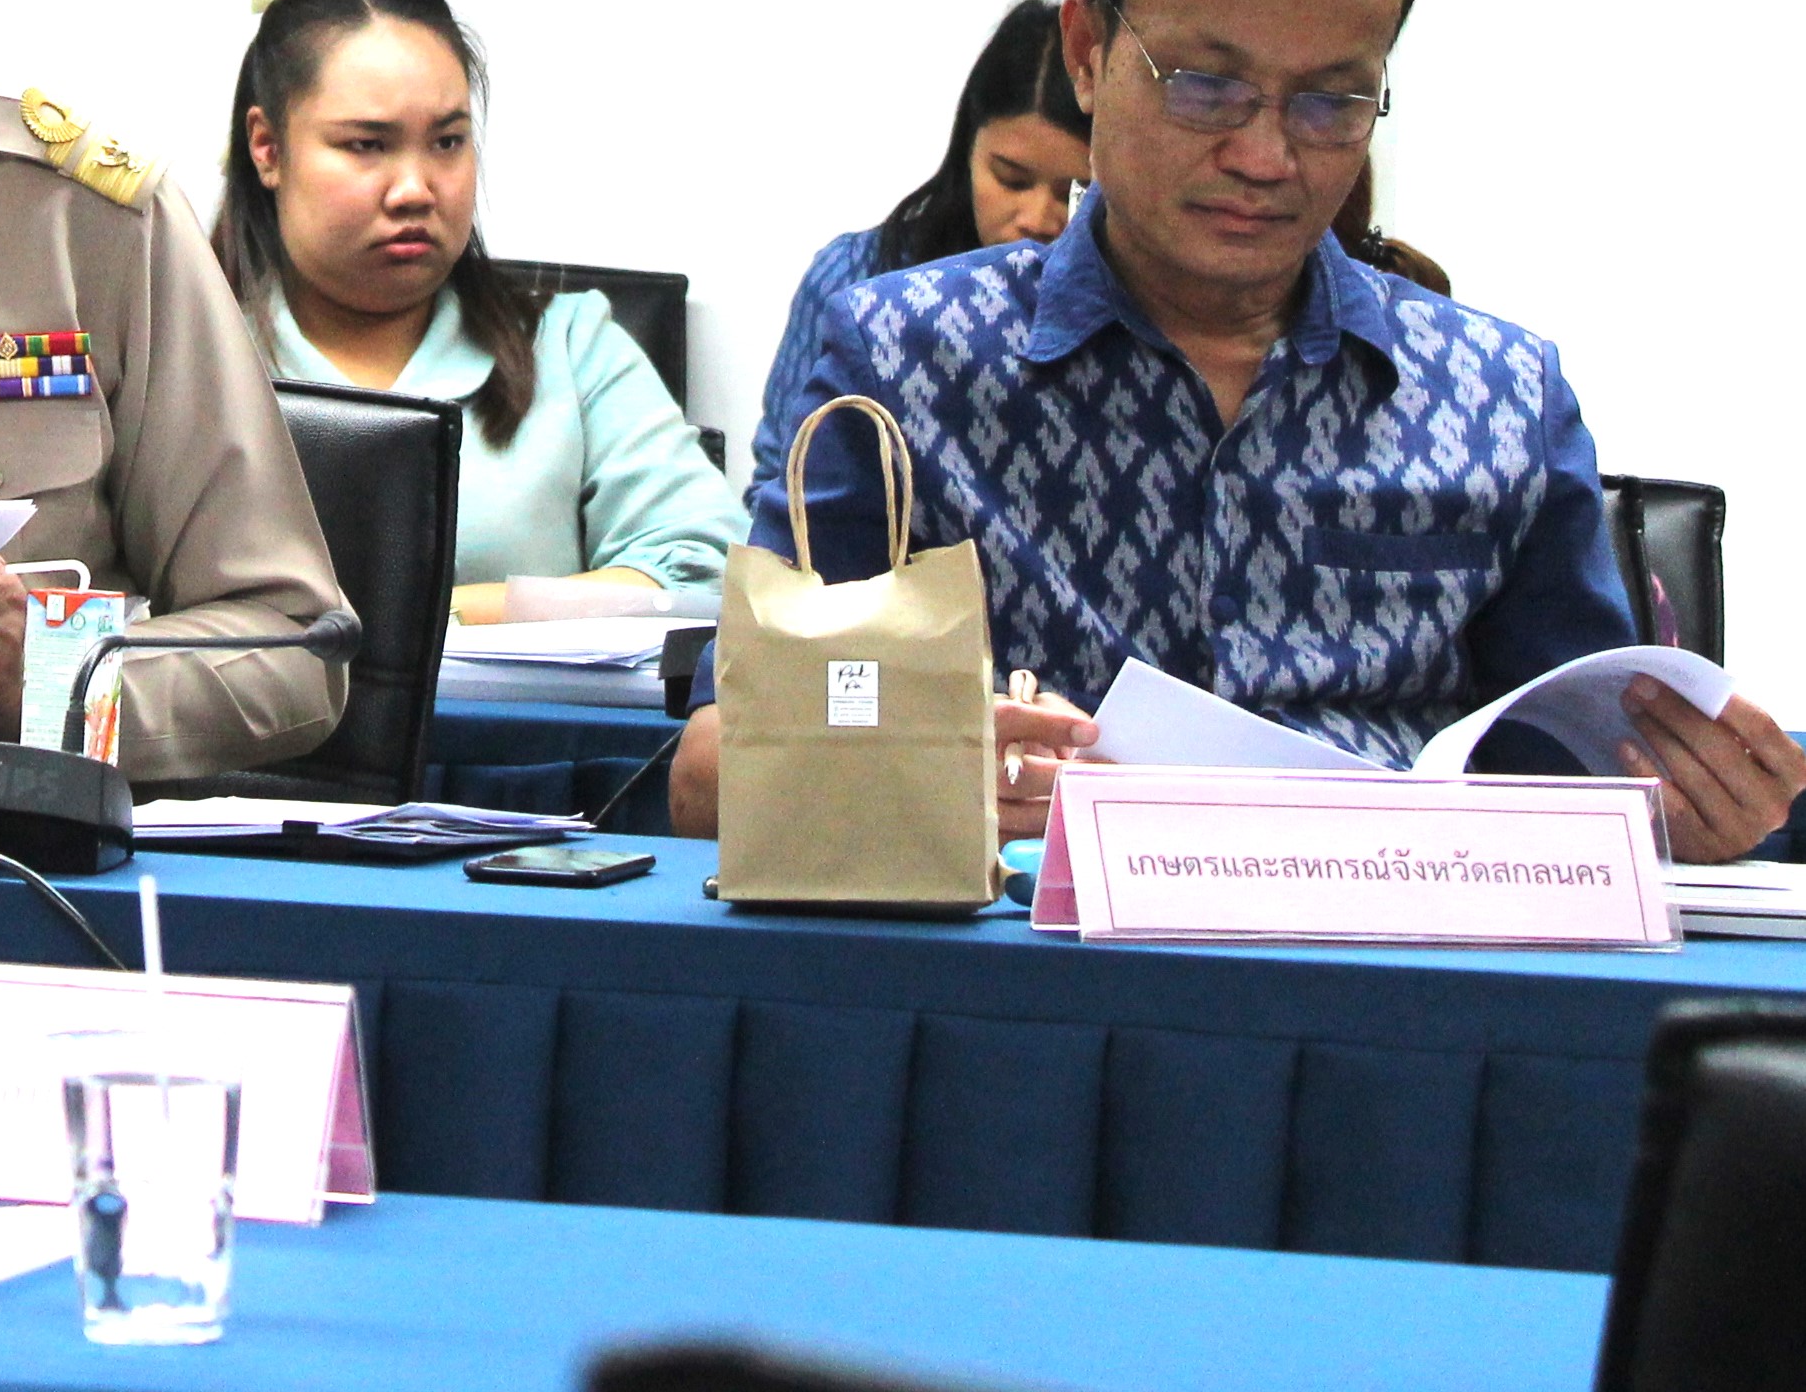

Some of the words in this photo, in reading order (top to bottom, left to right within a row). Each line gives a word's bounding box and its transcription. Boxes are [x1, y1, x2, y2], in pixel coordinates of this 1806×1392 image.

[1127, 847, 1613, 888] เกษตรและสหกรณ์จังหวัดสกลนคร
